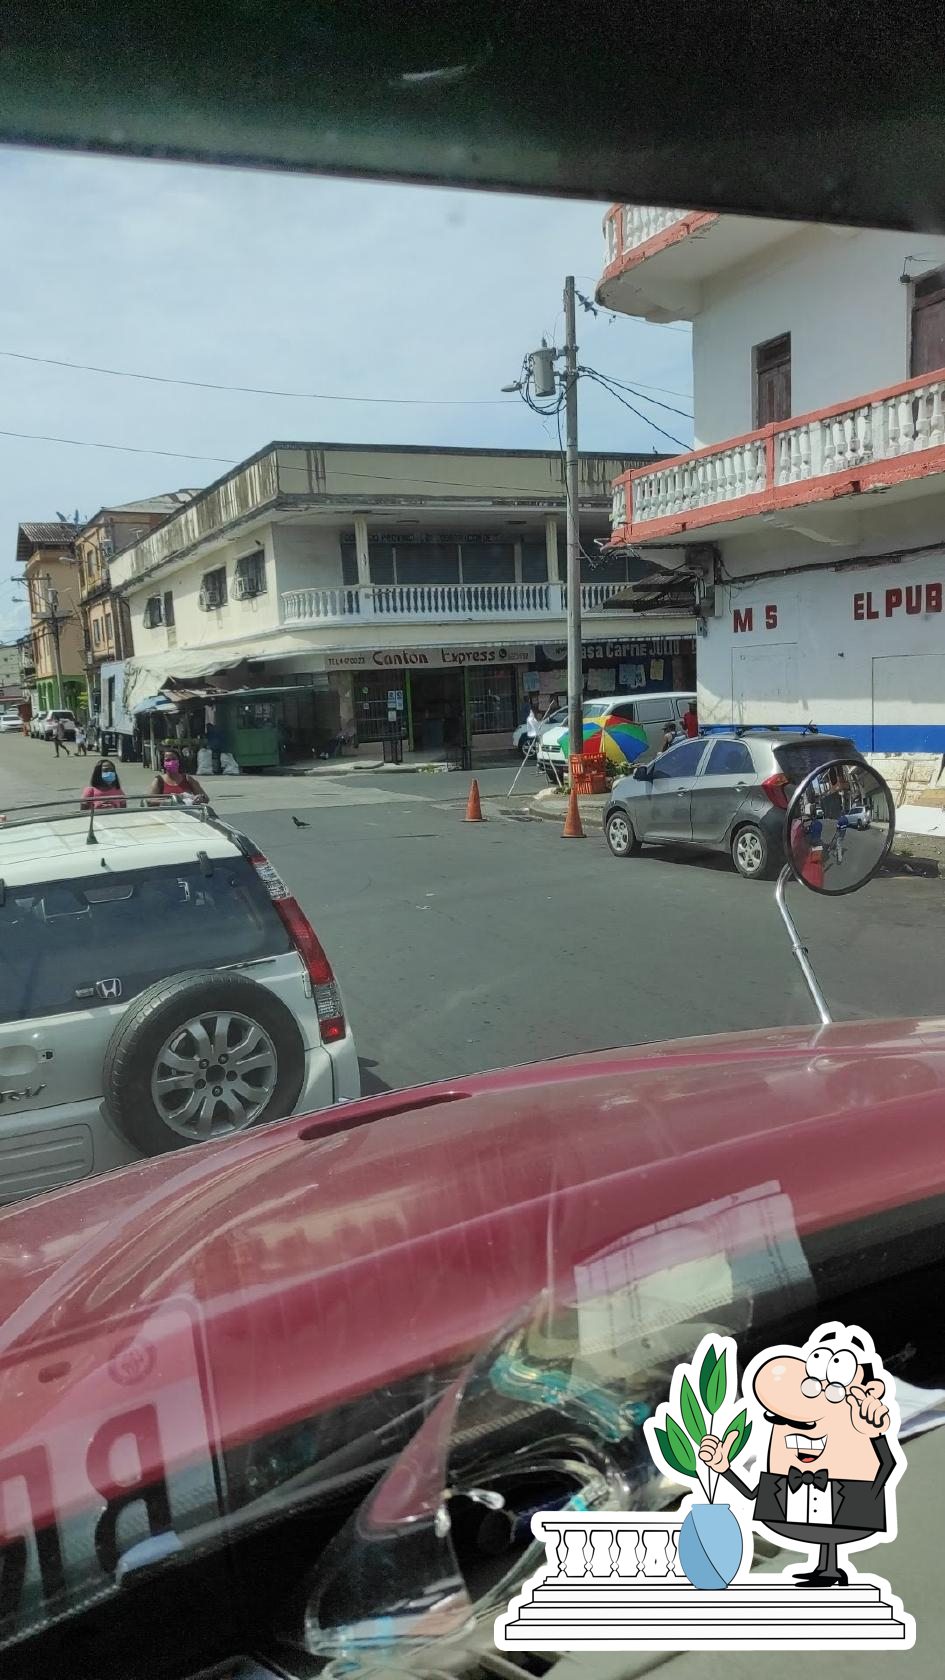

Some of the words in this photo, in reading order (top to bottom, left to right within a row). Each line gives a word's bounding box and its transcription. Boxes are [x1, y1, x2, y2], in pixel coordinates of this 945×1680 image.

[854, 592, 879, 621] EL
[885, 583, 943, 617] PUB
[733, 607, 753, 633] M
[765, 604, 778, 630] S
[372, 650, 429, 665] Canton
[441, 648, 496, 664] Express
[581, 645, 603, 659] asa
